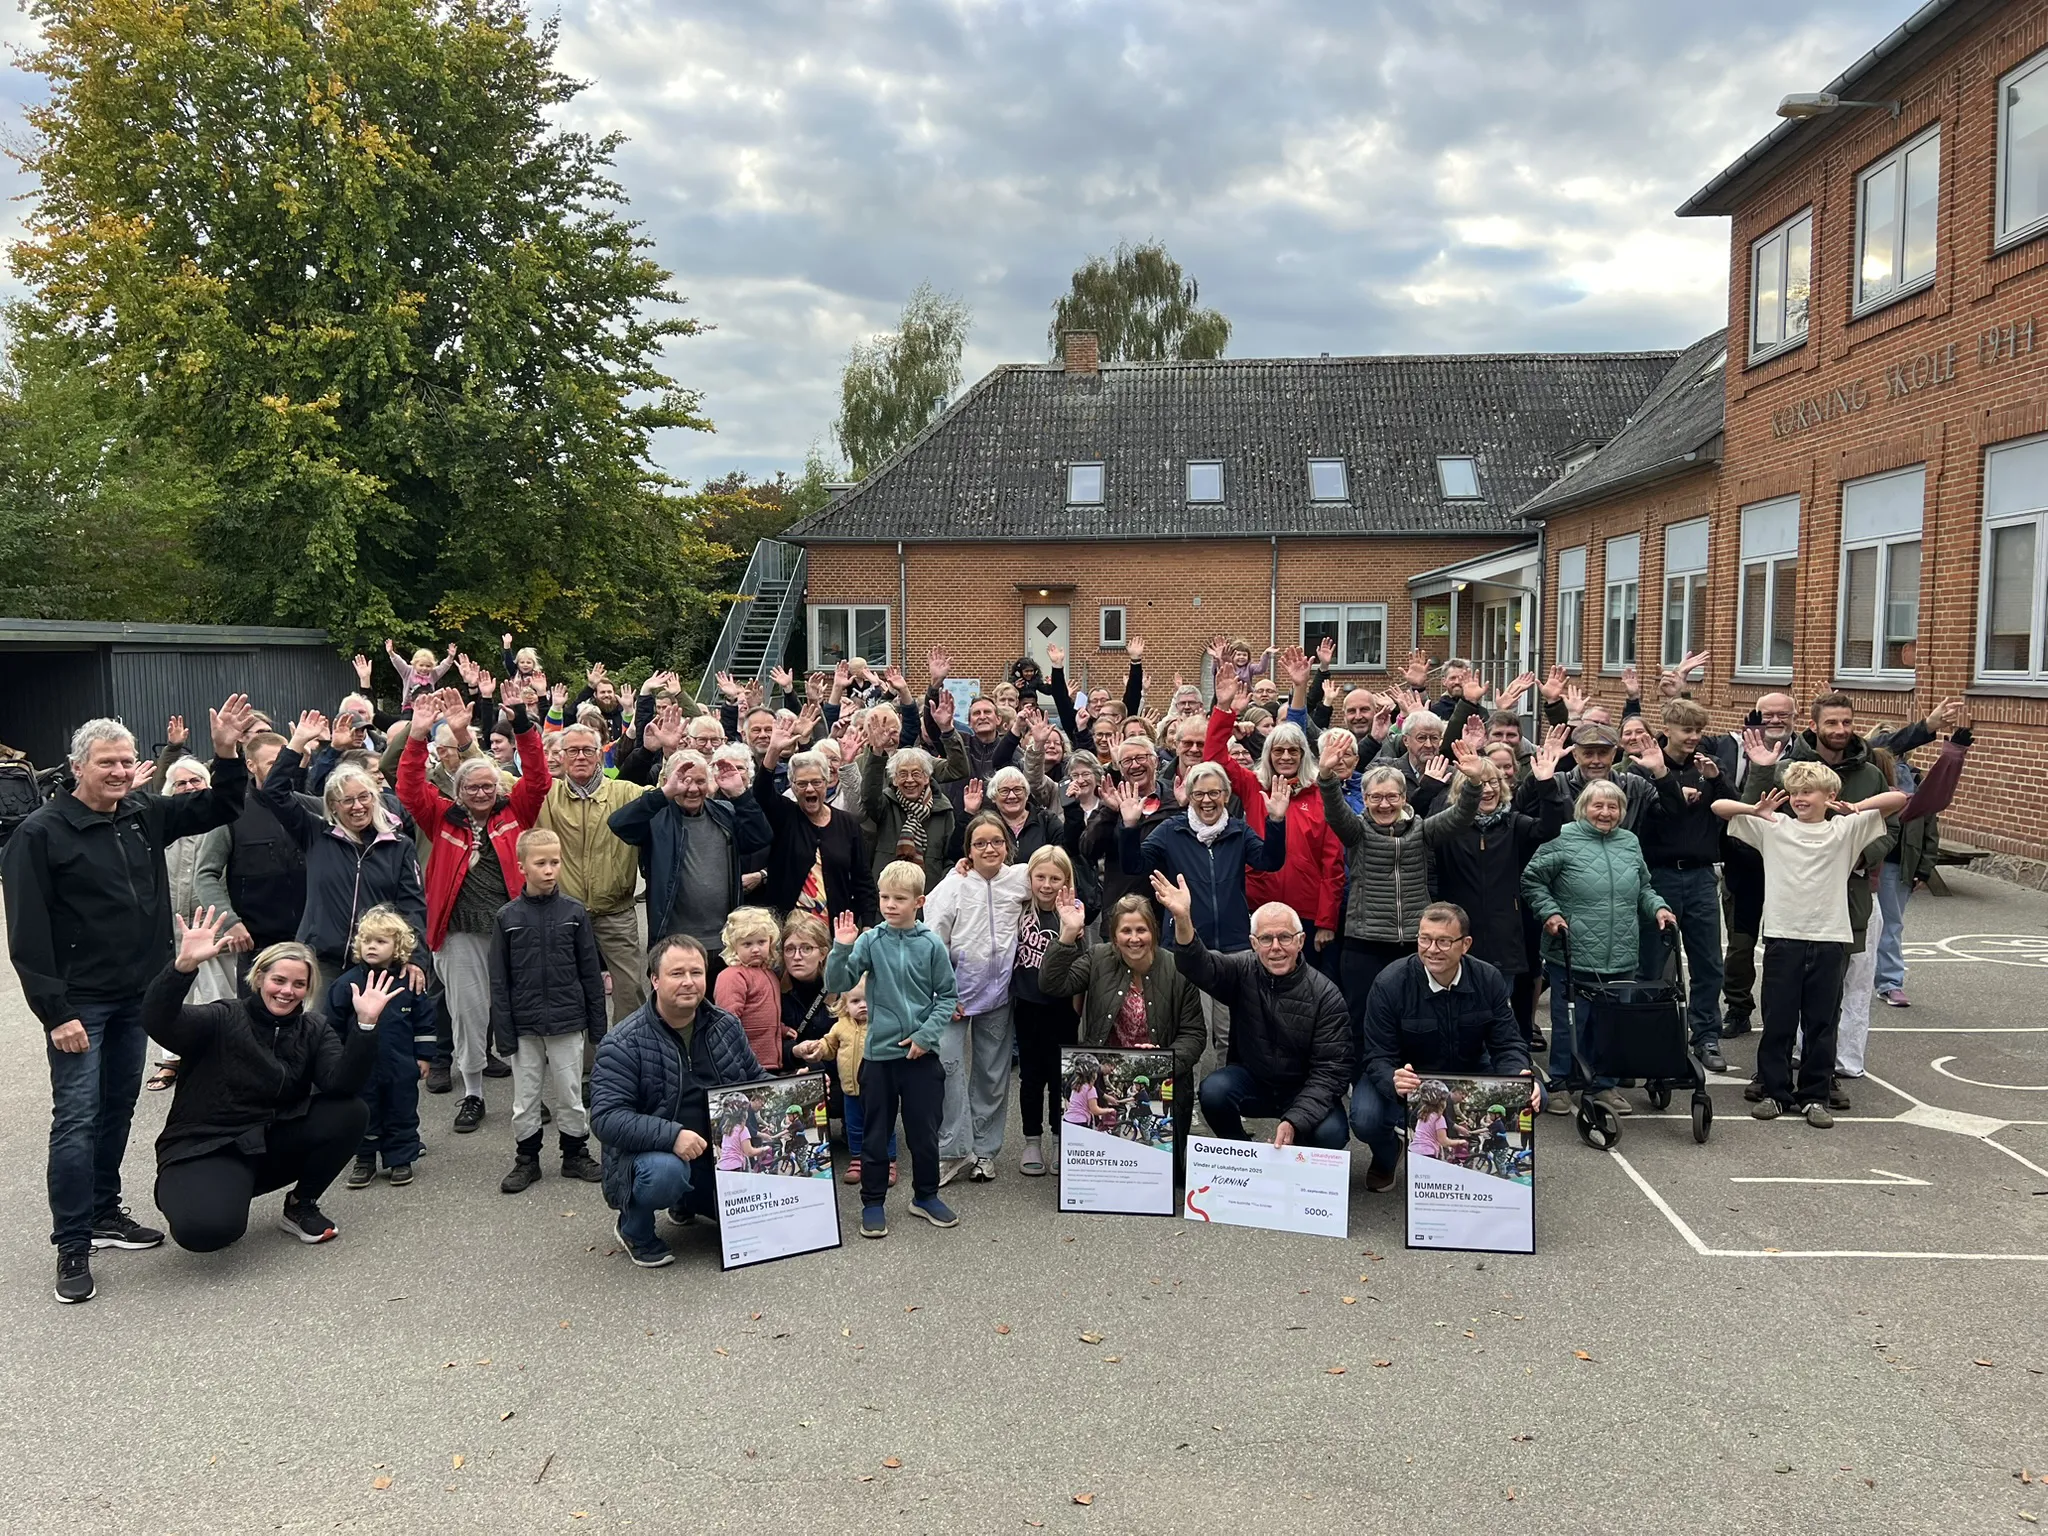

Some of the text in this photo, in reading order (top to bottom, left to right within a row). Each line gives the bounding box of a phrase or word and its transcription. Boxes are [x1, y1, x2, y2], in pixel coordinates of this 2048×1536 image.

[1771, 314, 2037, 438] KORNING SKOLE 1944
[1067, 1149, 1095, 1157] VINDER
[1194, 1142, 1258, 1158] Gavecheck
[1067, 1157, 1138, 1167] LOKALDYSTEN 2025
[1217, 1164, 1248, 1172] Lokaldysten
[1211, 1175, 1250, 1188] KORNING
[1414, 1182, 1453, 1191] NUMMER
[725, 1194, 761, 1207] NUMMER
[763, 1193, 768, 1201] 3
[1414, 1190, 1493, 1202] LOKALDYSTEN 2025
[725, 1200, 779, 1216] LOKALDYSTEN
[780, 1195, 800, 1206] 2025
[1304, 1207, 1333, 1218] 5000,-
